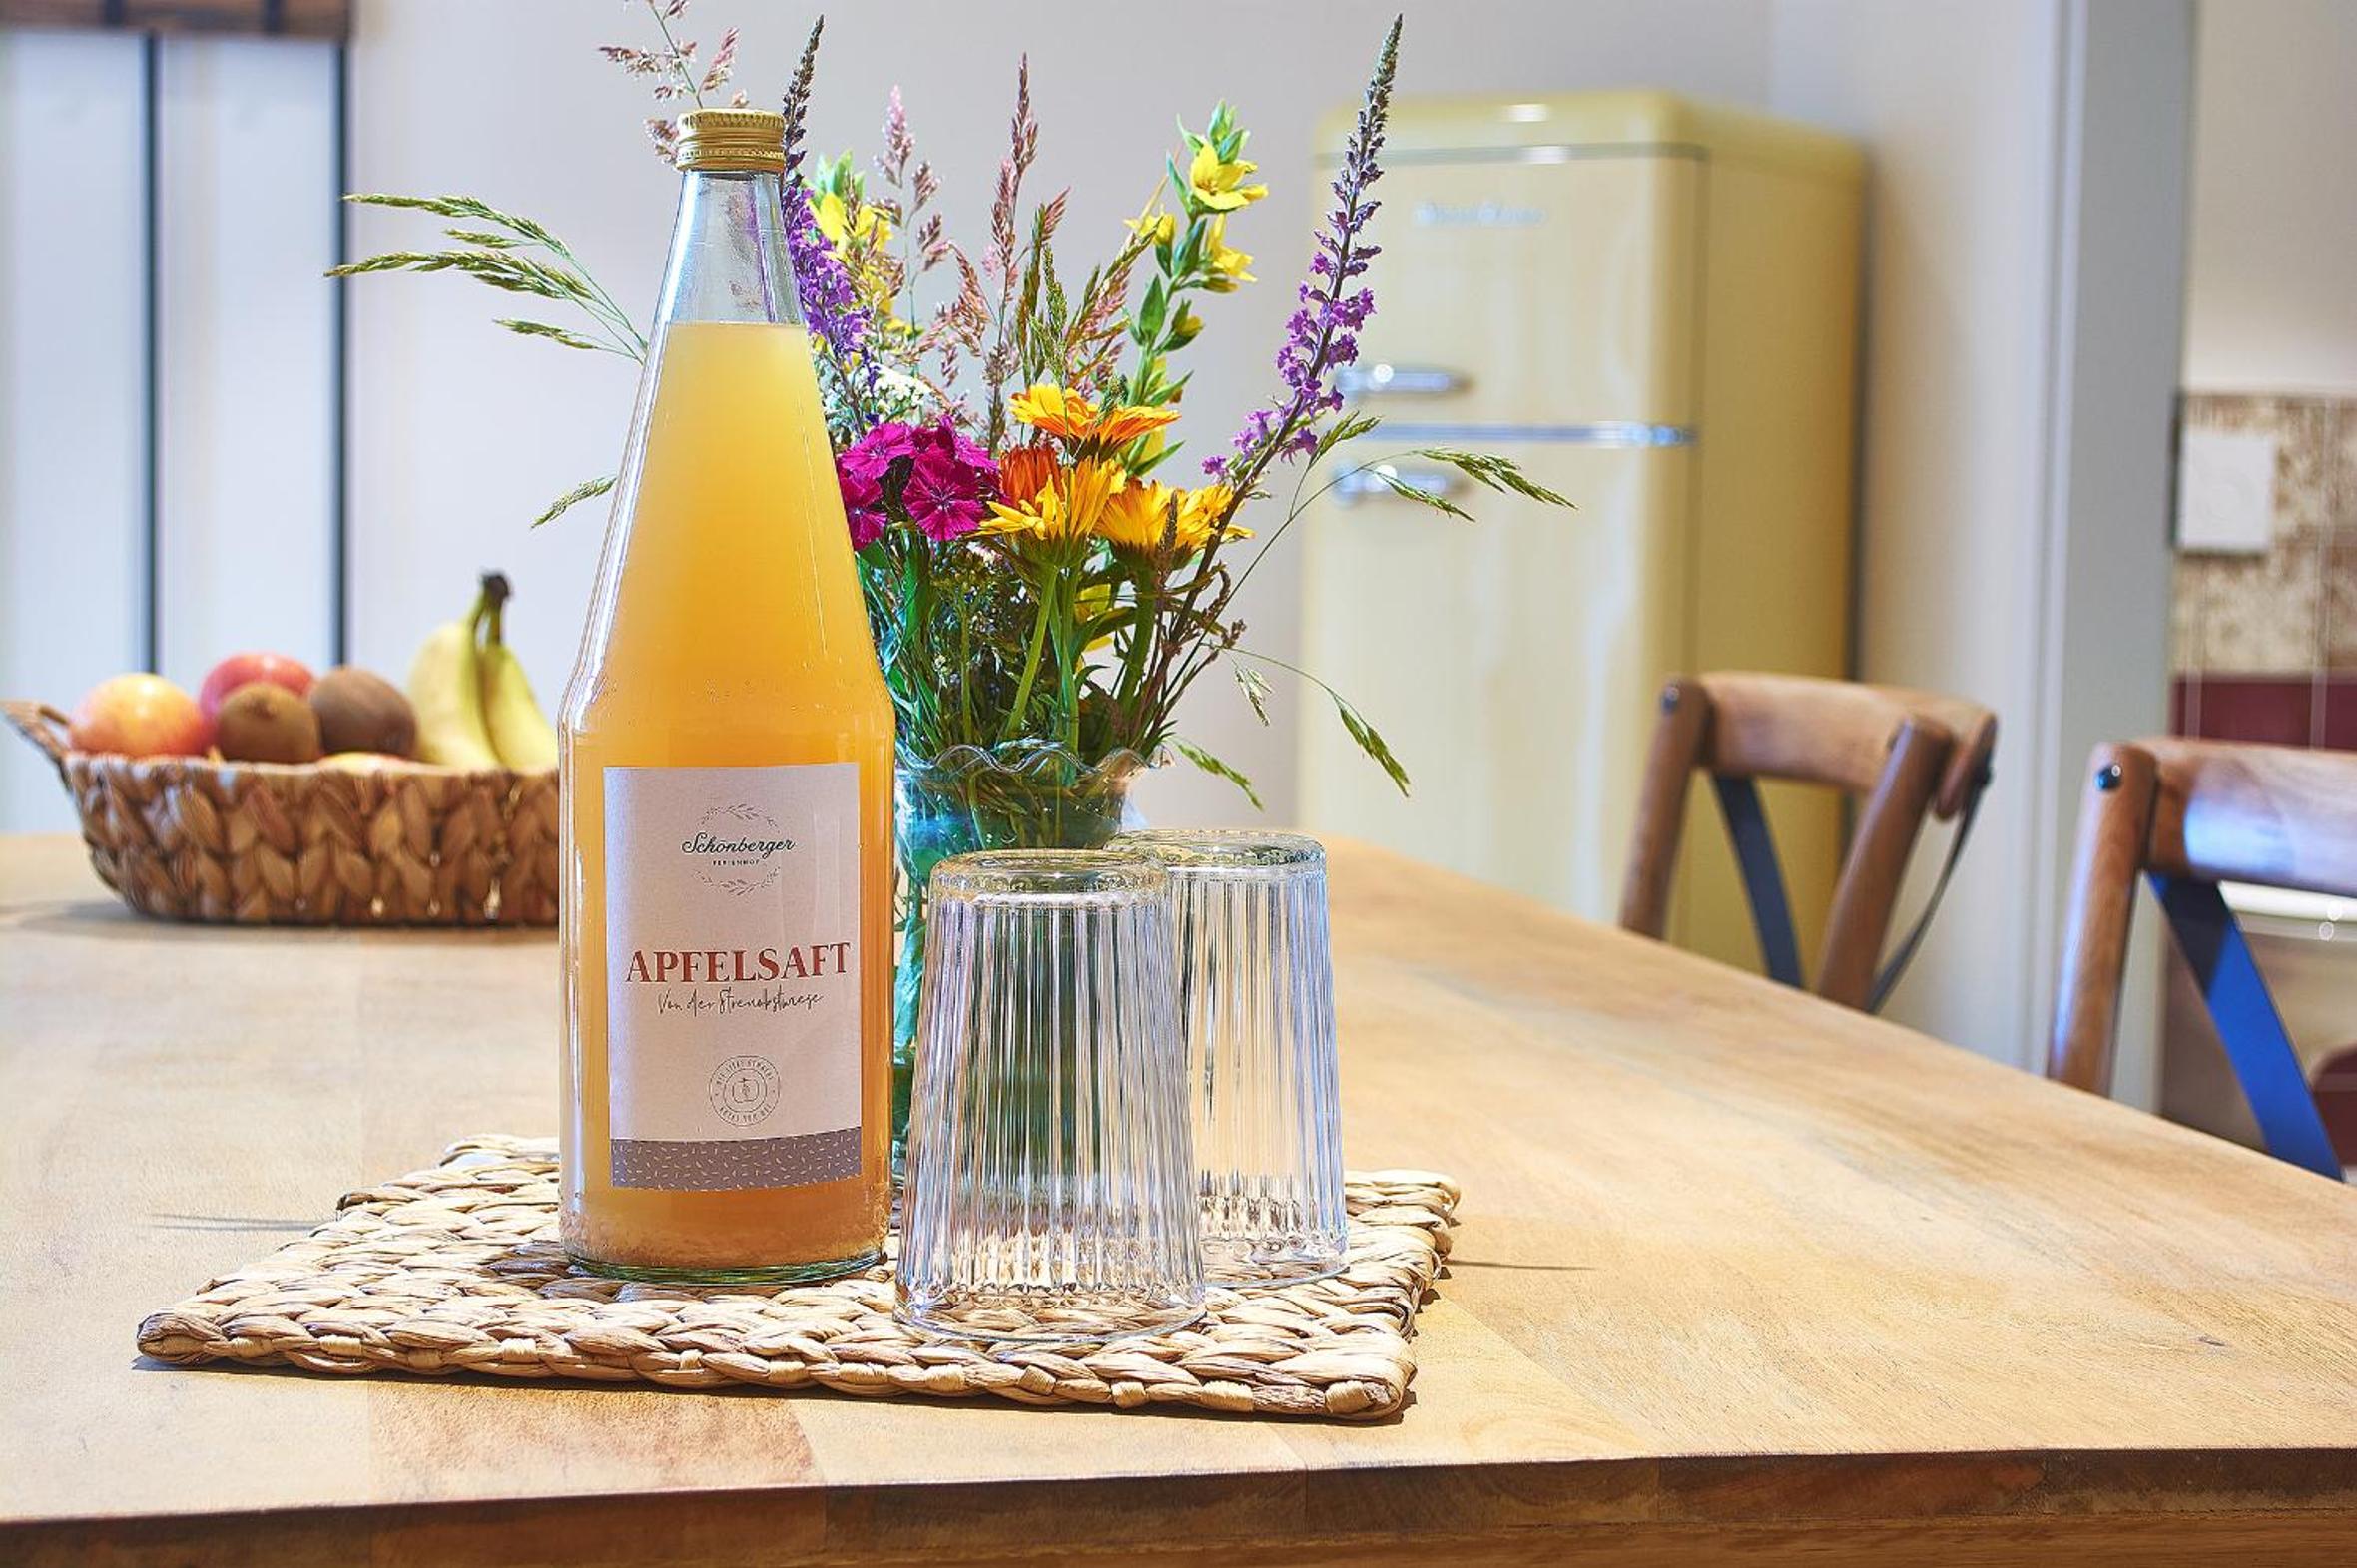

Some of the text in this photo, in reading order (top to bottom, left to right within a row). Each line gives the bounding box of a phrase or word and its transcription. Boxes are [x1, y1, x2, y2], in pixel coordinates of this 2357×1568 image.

[681, 831, 795, 859] Schönberger
[625, 942, 851, 983] APFELSAFT
[686, 988, 715, 1017] der
